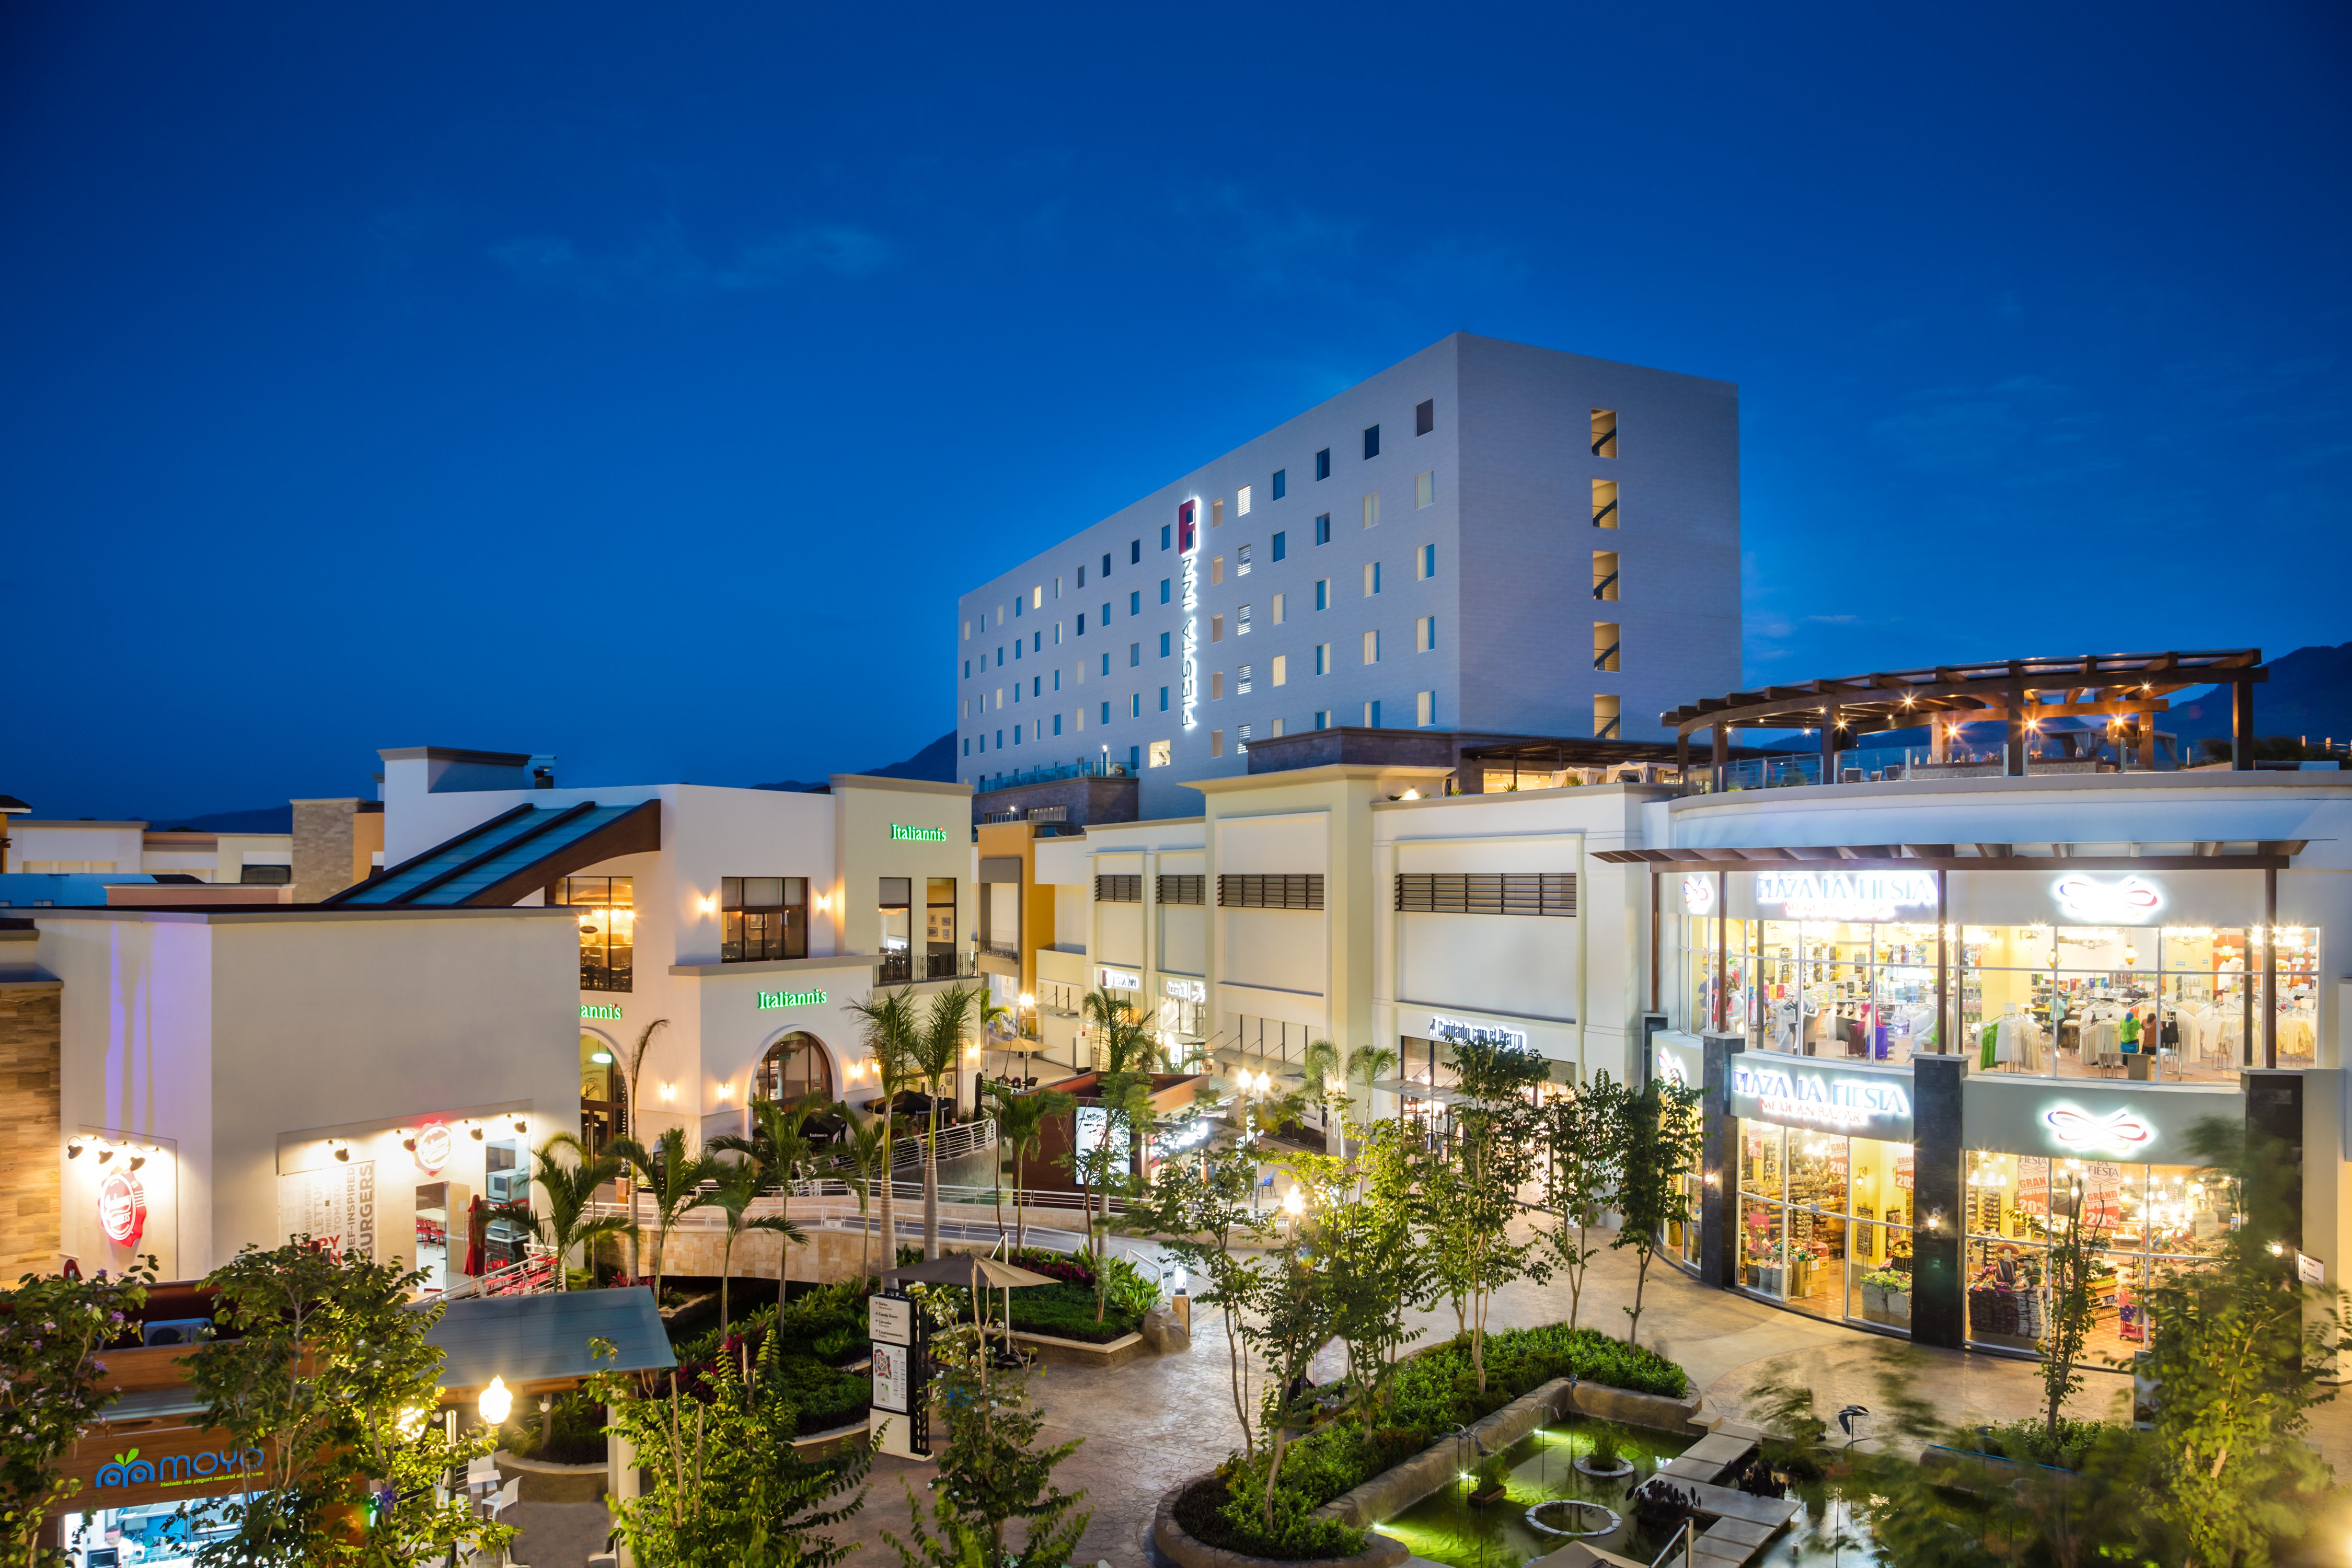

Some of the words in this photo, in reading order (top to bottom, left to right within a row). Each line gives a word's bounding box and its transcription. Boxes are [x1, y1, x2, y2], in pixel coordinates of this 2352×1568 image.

[1182, 558, 1194, 608] INN
[1182, 619, 1193, 727] FIESTA
[891, 823, 947, 841] Italianni's
[1757, 878, 1813, 898] PLAZA
[1824, 879, 1847, 899] LA
[1859, 879, 1931, 900] FIESTA
[757, 987, 827, 1009] Italianni's
[580, 1003, 622, 1020] anni's
[1438, 1020, 1470, 1040] Cuidado
[1472, 1028, 1487, 1043] con
[1498, 1028, 1523, 1050] Perro
[1733, 1070, 1788, 1098] PLAZA
[1798, 1080, 1822, 1103] LA
[1832, 1084, 1904, 1112] FIESTA
[1831, 1143, 1847, 1152] GRA
[1897, 1156, 1914, 1165] GRAN
[2019, 1155, 2047, 1166] FIESTA
[2088, 1166, 2119, 1177] FIESTA
[2019, 1177, 2047, 1188] GRAN
[2087, 1190, 2117, 1201] GRAND
[2019, 1199, 2048, 1214] 20%
[2086, 1200, 2119, 1210] OPENING
[2086, 1212, 2119, 1227] 20%
